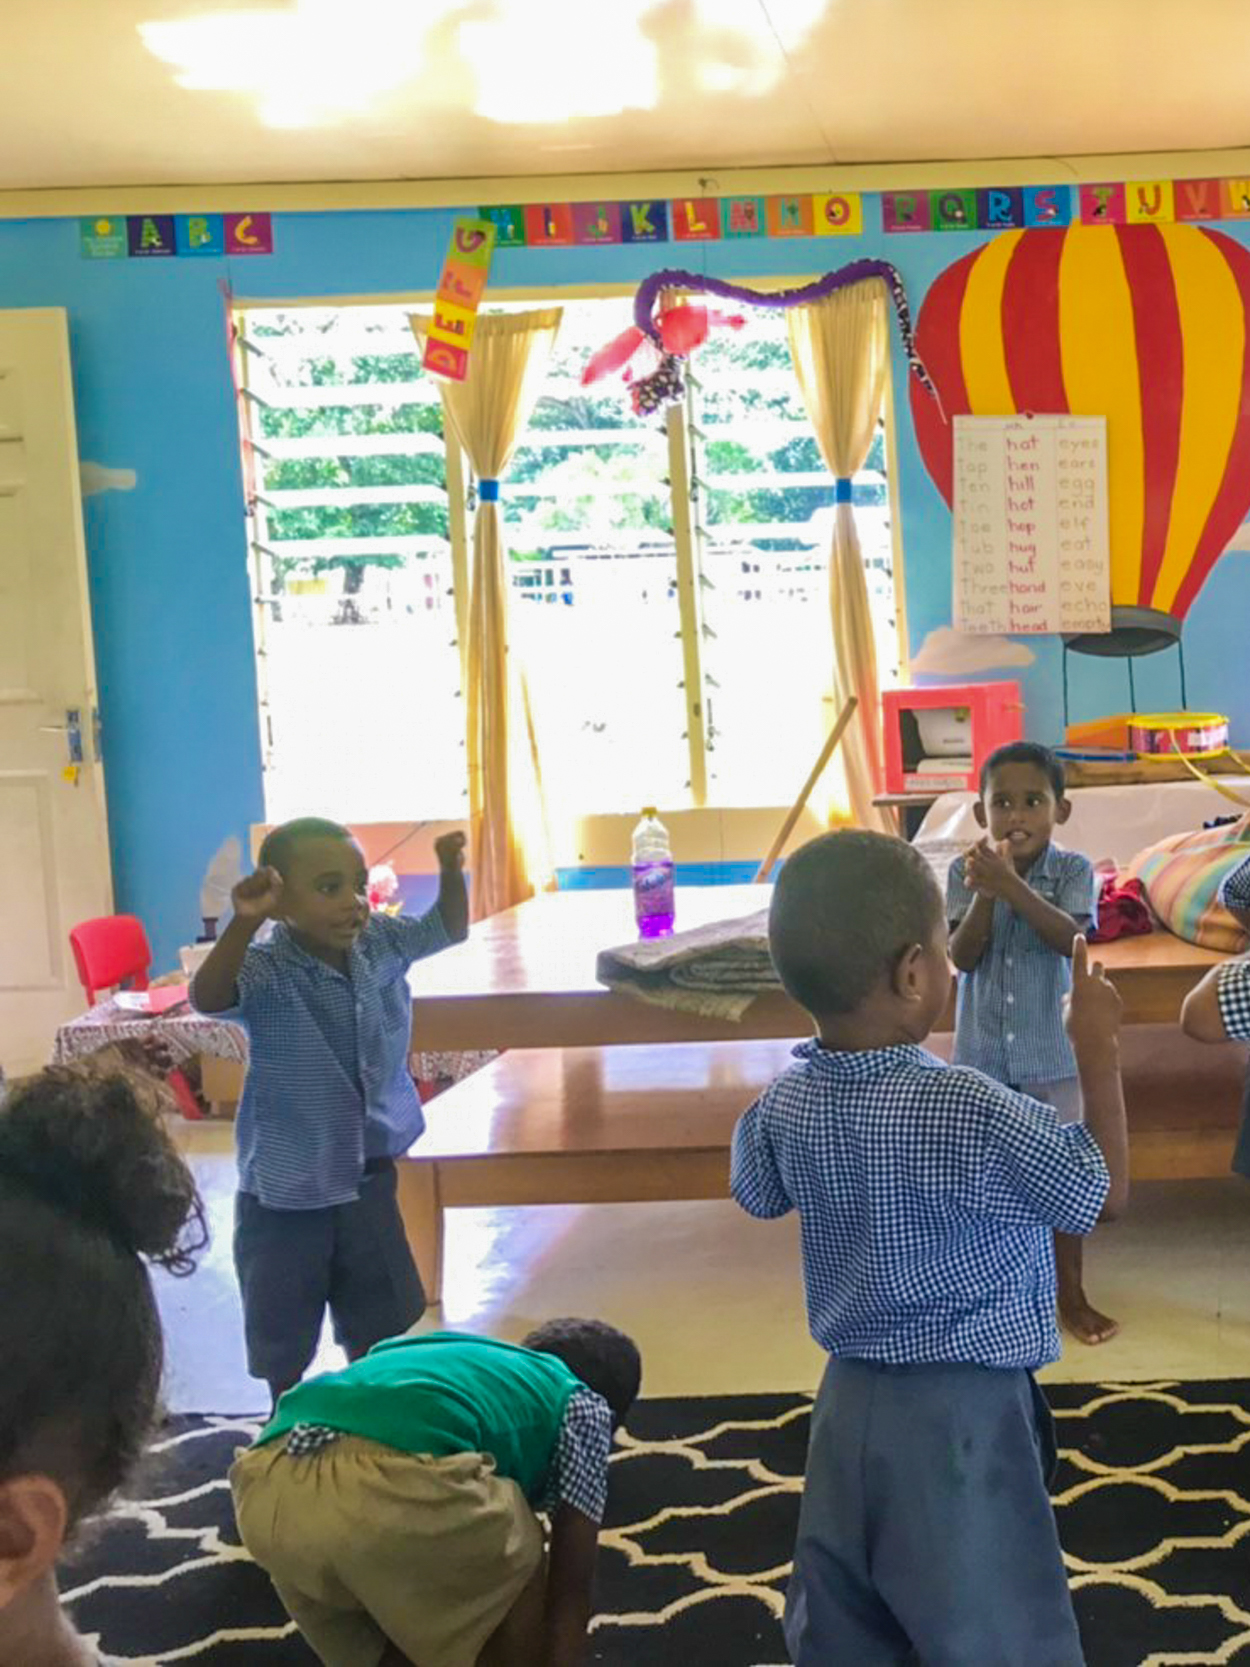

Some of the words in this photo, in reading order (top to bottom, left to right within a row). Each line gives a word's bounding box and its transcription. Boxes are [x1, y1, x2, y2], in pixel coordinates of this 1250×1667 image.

[988, 190, 1013, 222] R
[1034, 190, 1059, 222] S
[1137, 184, 1161, 215] U
[1184, 181, 1208, 214] V
[630, 203, 655, 234] K
[684, 200, 707, 232] L
[825, 196, 851, 226] O
[141, 217, 163, 248] A
[234, 214, 259, 245] C
[434, 313, 465, 335] E
[1007, 455, 1040, 471] hen
[1008, 475, 1035, 492] hill
